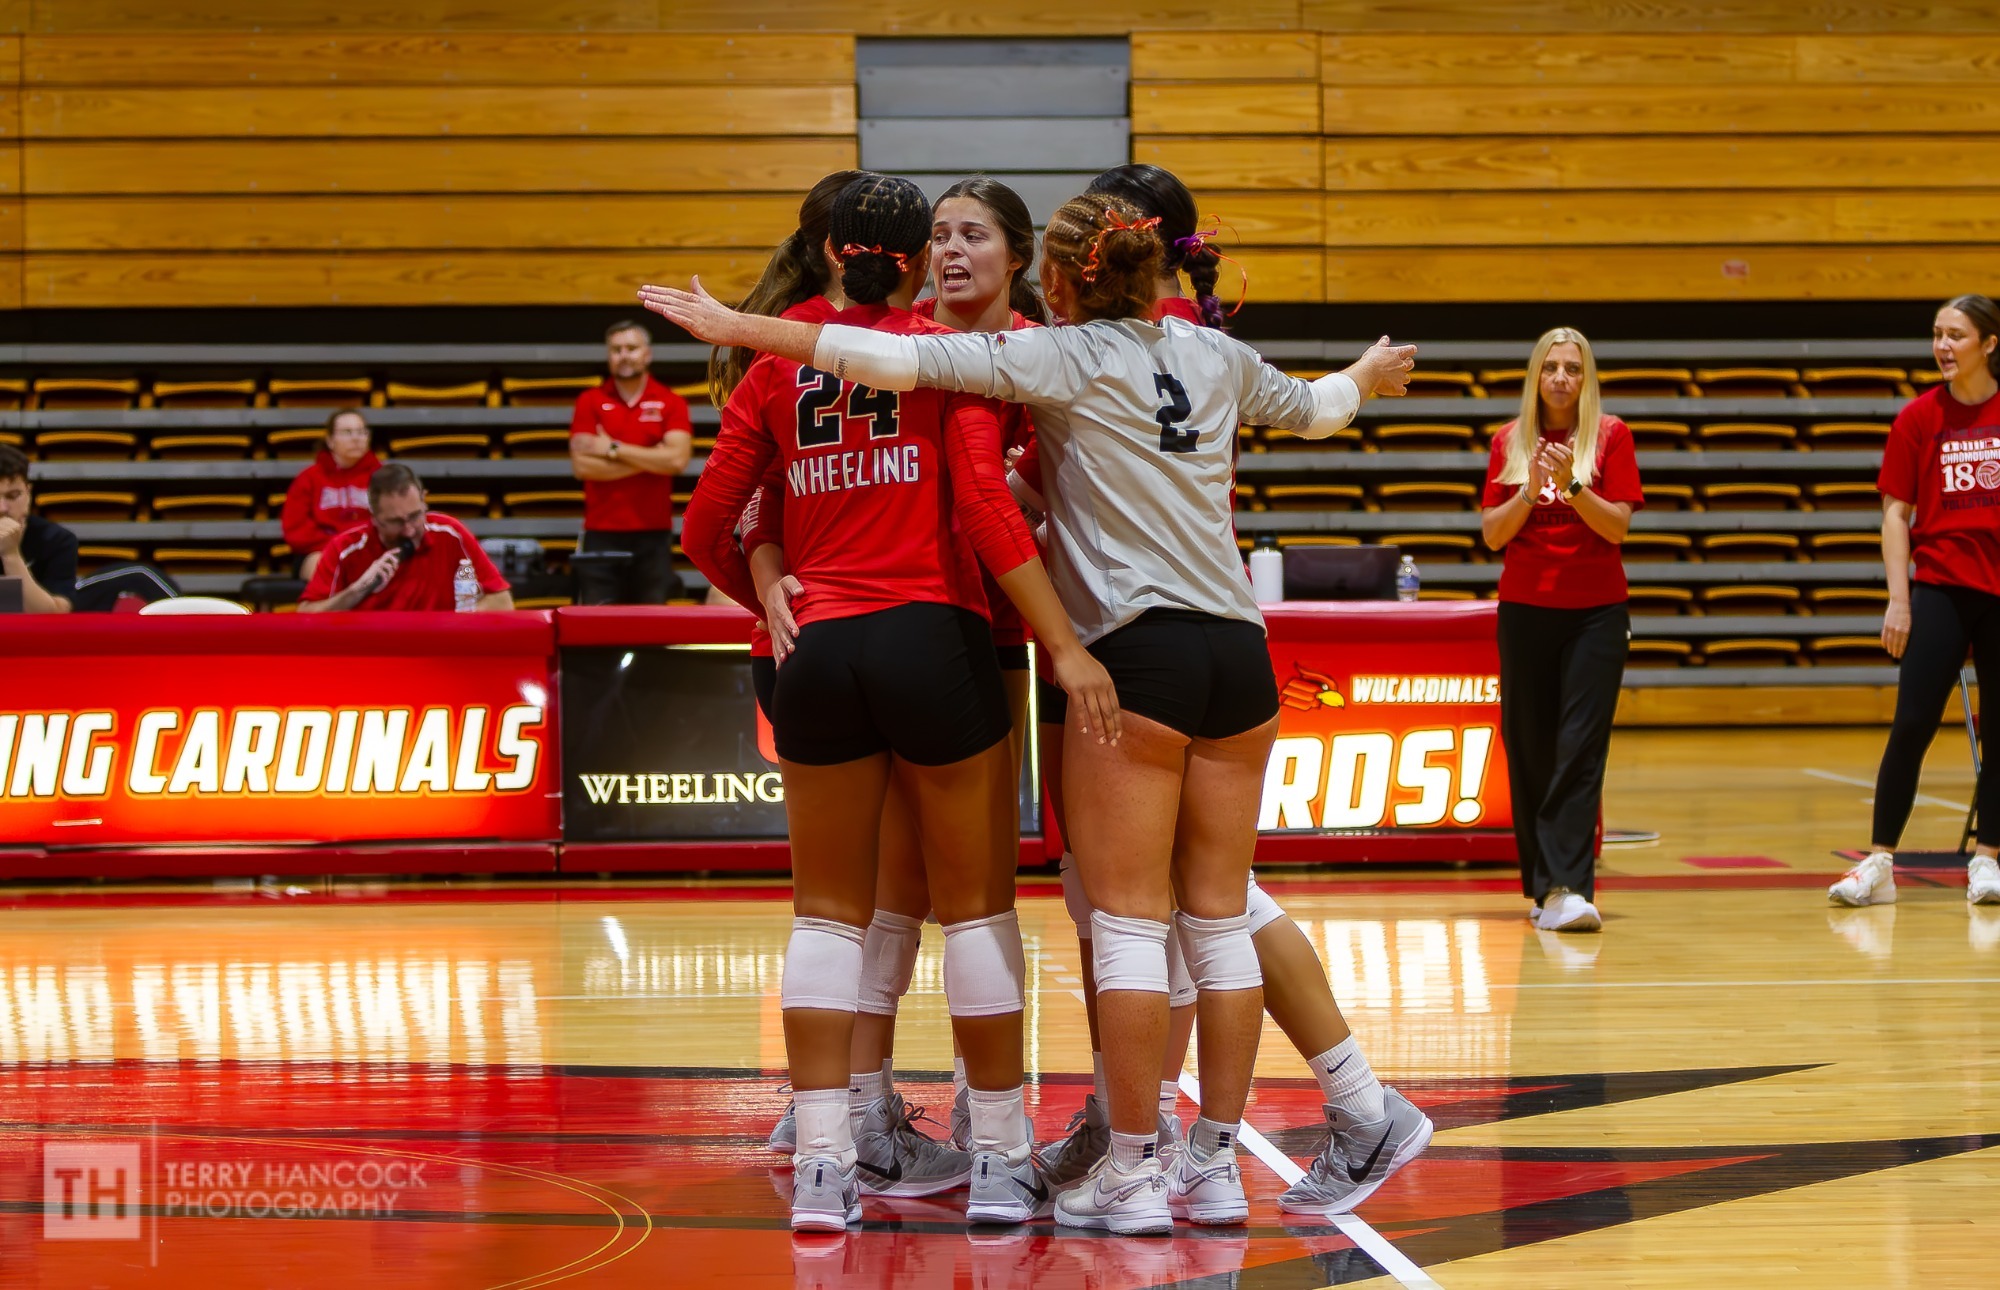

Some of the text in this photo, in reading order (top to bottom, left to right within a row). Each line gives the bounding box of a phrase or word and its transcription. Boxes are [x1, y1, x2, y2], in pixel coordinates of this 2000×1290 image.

[796, 364, 900, 450] 24
[1152, 372, 1200, 453] 2
[787, 445, 919, 498] WHEELING
[129, 705, 542, 796] CARDINALS
[578, 772, 785, 804] WHEELING
[1256, 726, 1493, 831] RDS!
